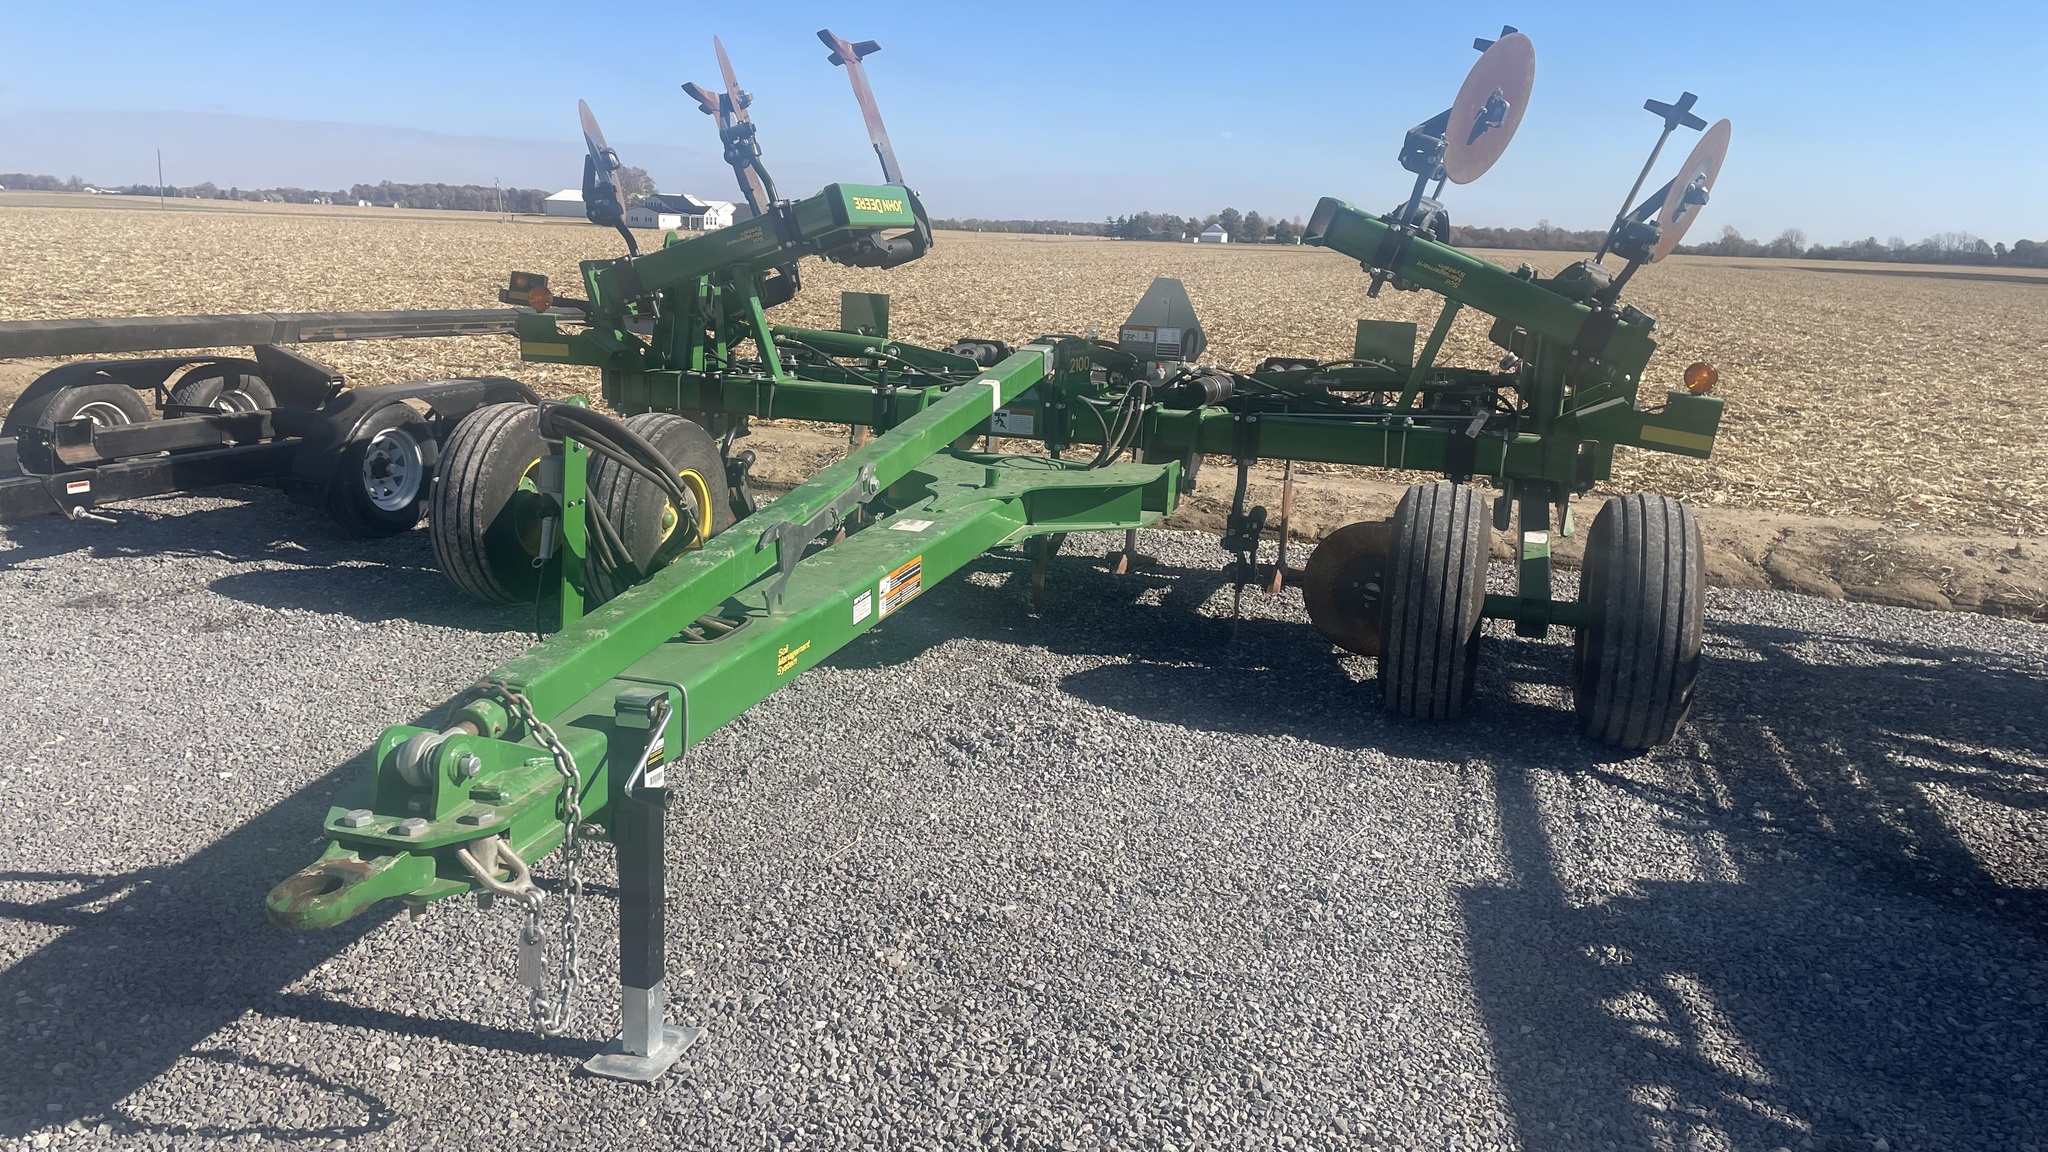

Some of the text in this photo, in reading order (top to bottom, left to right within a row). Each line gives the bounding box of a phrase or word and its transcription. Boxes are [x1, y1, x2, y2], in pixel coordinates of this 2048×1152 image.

[852, 195, 904, 215] JOHN DEERE
[1416, 260, 1463, 284] Management
[1437, 262, 1467, 279] System
[1444, 278, 1460, 289] Soil
[1069, 355, 1090, 374] 2100
[777, 643, 790, 658] Soil
[777, 639, 811, 667] Management
[776, 657, 798, 676] System
